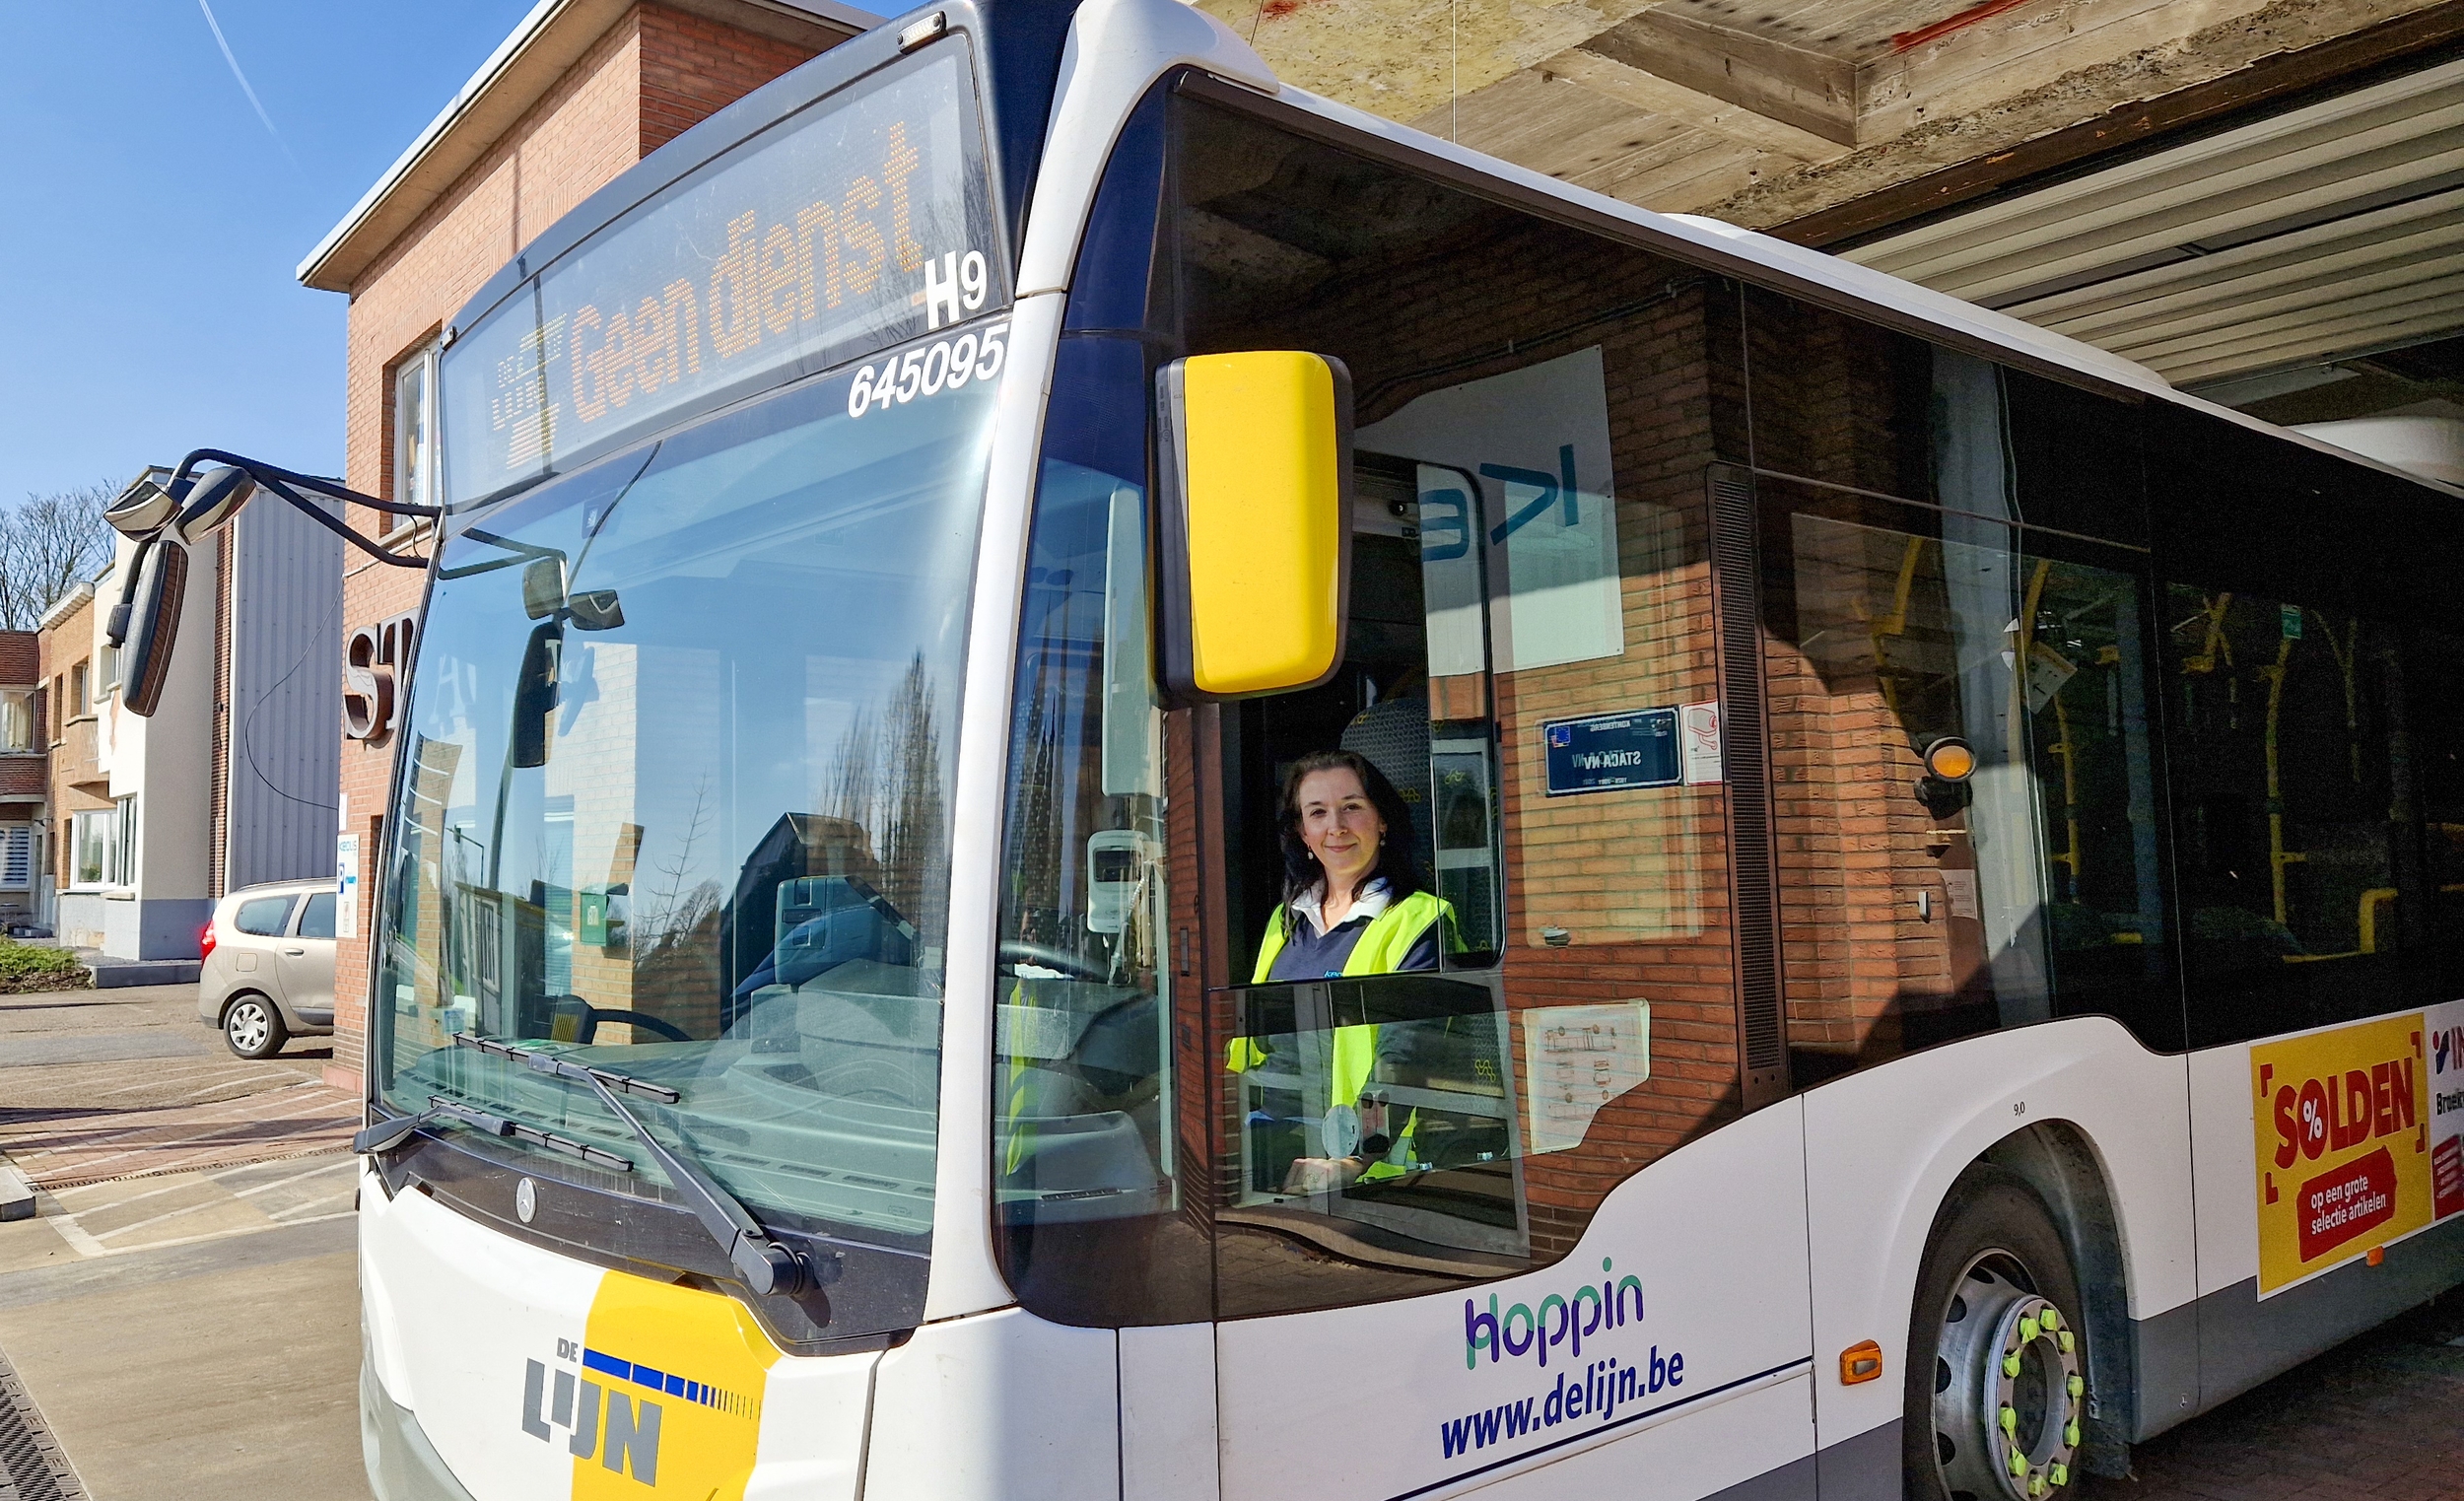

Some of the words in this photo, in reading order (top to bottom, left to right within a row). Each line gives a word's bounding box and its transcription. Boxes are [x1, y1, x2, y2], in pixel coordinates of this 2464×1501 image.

[570, 276, 702, 423] Geen
[708, 120, 923, 359] dienst
[924, 249, 987, 330] H9
[848, 322, 1009, 418] 645095
[2274, 1057, 2416, 1170] SOLDEN
[2310, 1193, 2324, 1213] op
[2325, 1186, 2343, 1202] een
[2344, 1175, 2368, 1200] grote
[2311, 1204, 2348, 1235] selectie
[2349, 1194, 2386, 1222] artikelen
[556, 1336, 579, 1363] DE
[521, 1357, 663, 1488] LIJN
[1441, 1344, 1684, 1460] www.delijn.be
